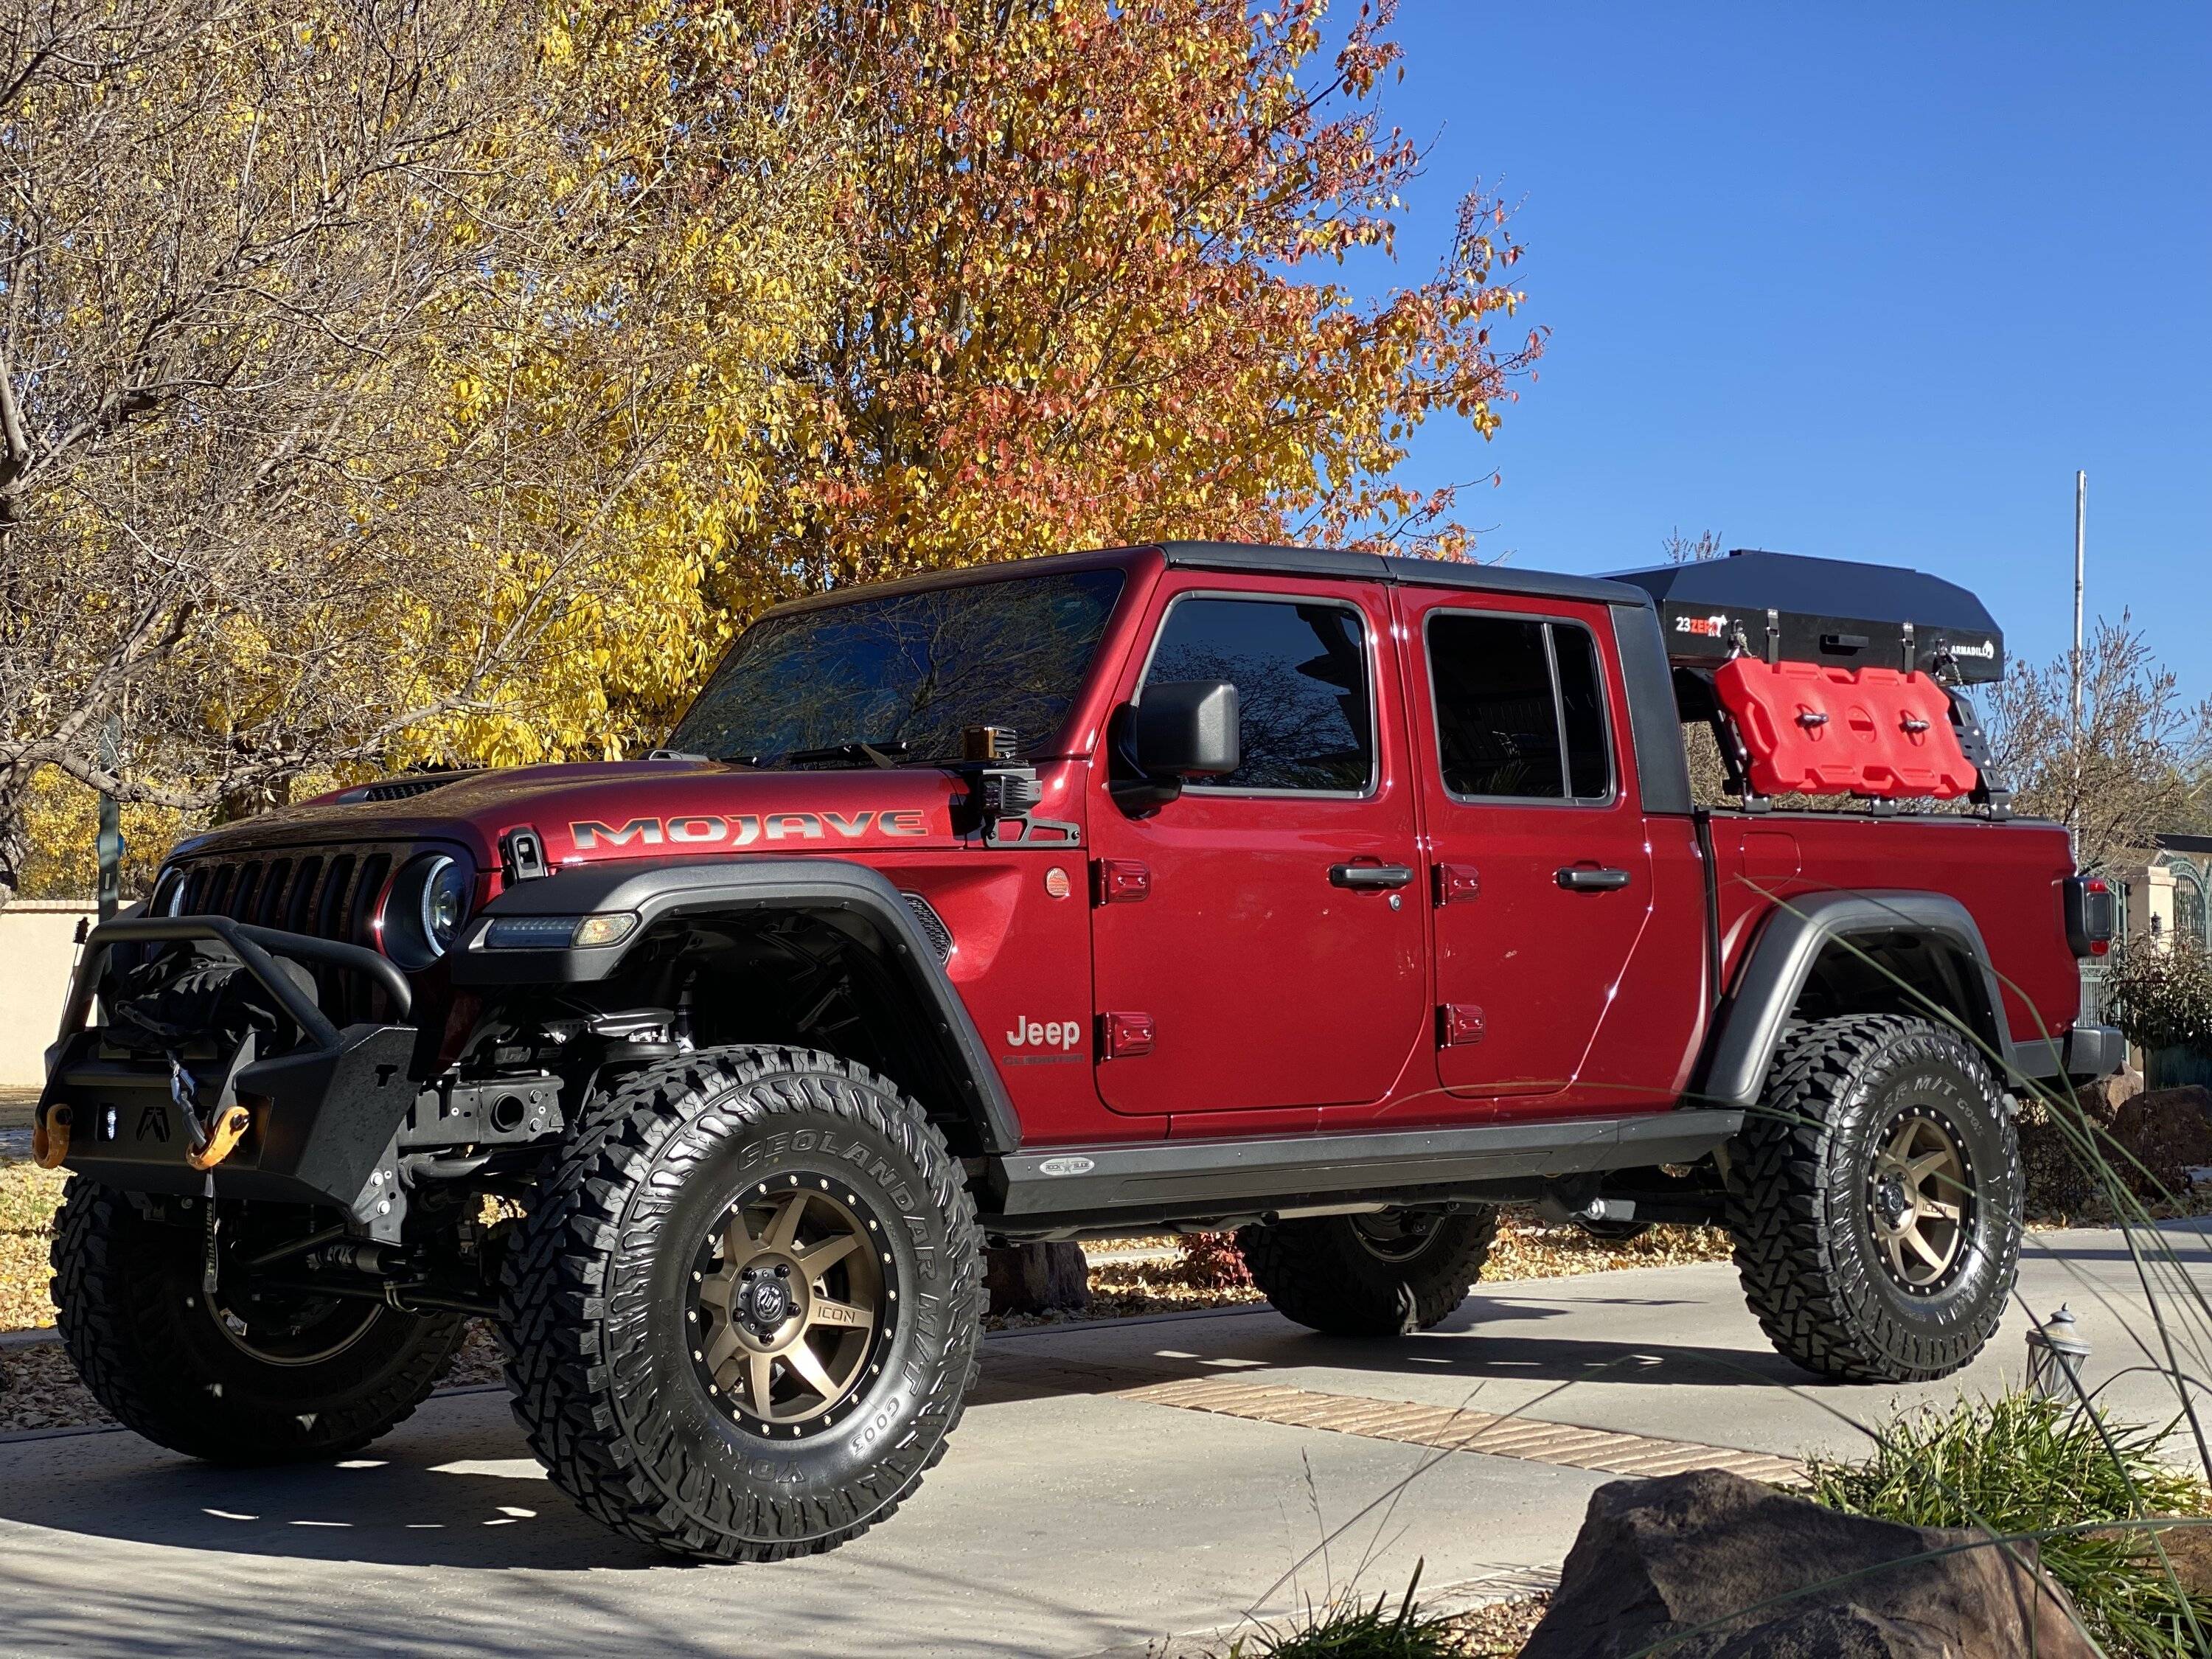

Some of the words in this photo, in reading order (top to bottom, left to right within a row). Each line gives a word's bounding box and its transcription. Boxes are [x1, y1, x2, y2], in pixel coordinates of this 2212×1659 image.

[568, 810, 929, 850] MOJAVE
[1006, 1015, 1080, 1050] Jeep
[737, 1129, 938, 1281] GEOLANDAR
[818, 1305, 855, 1324] ICON
[903, 1293, 940, 1397] M/T
[850, 1396, 901, 1457] G003
